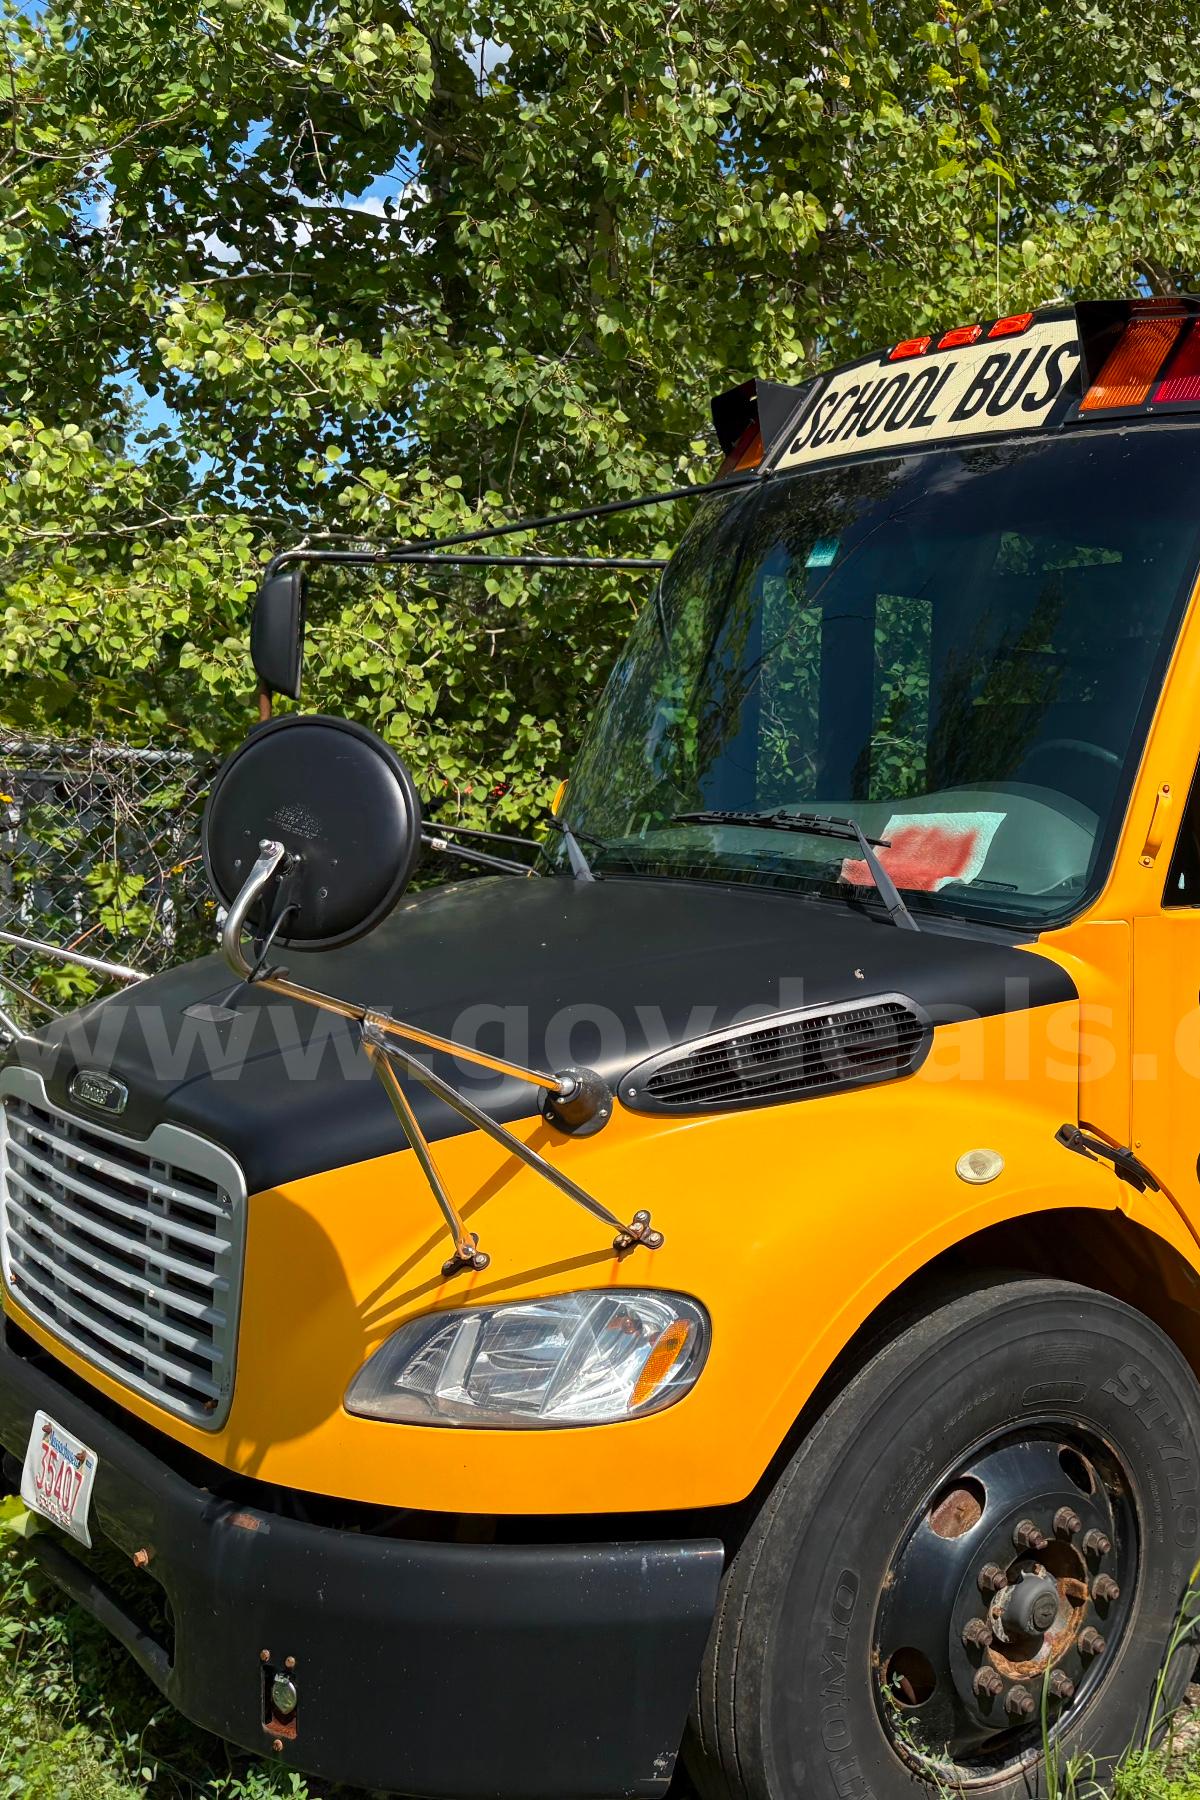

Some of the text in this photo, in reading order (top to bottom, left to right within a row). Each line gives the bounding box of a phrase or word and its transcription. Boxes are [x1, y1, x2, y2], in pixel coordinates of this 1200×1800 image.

[789, 340, 1080, 455] SCHOOL BUS
[36, 1442, 84, 1516] 35407
